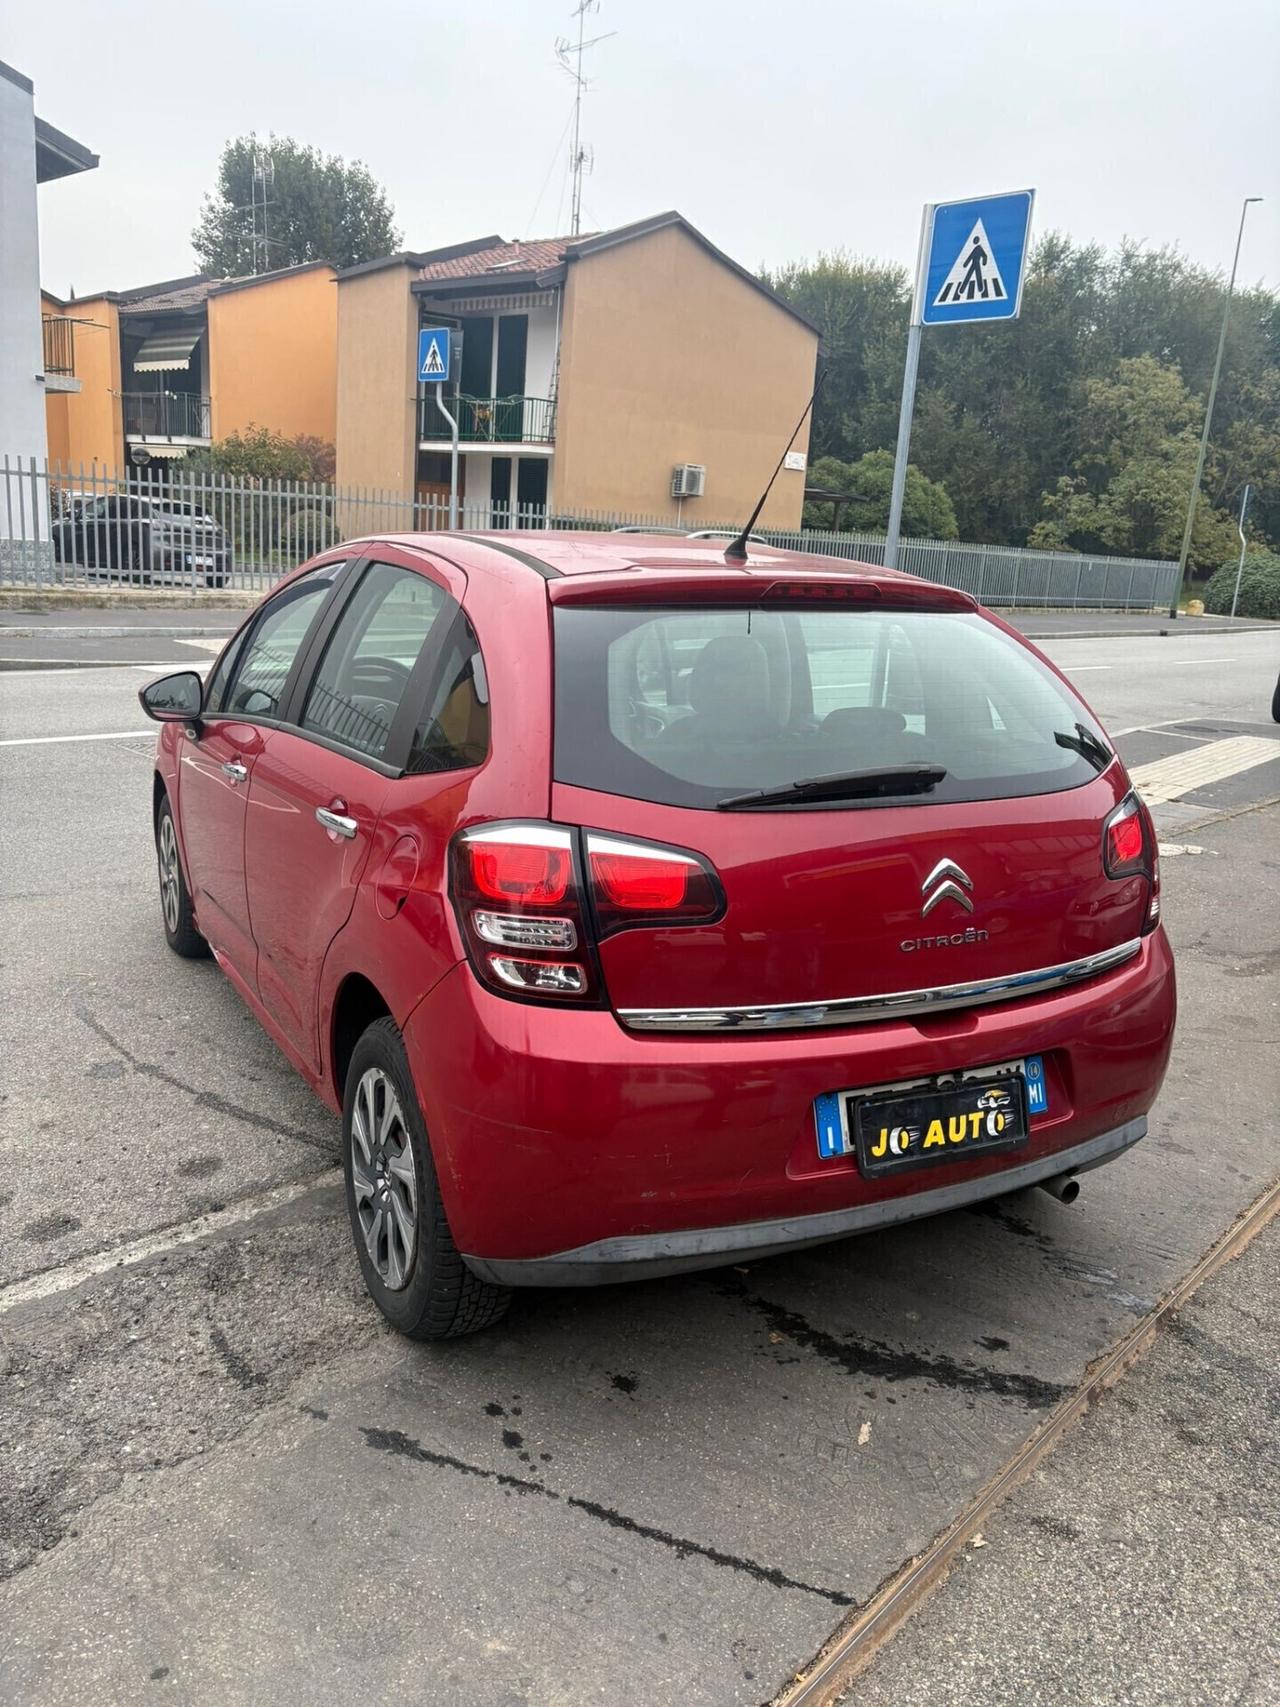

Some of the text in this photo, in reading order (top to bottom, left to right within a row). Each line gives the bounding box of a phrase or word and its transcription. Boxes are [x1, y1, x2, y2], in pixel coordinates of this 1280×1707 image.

[1028, 1082, 1043, 1104] MI
[872, 1110, 1005, 1157] JO AUTO
